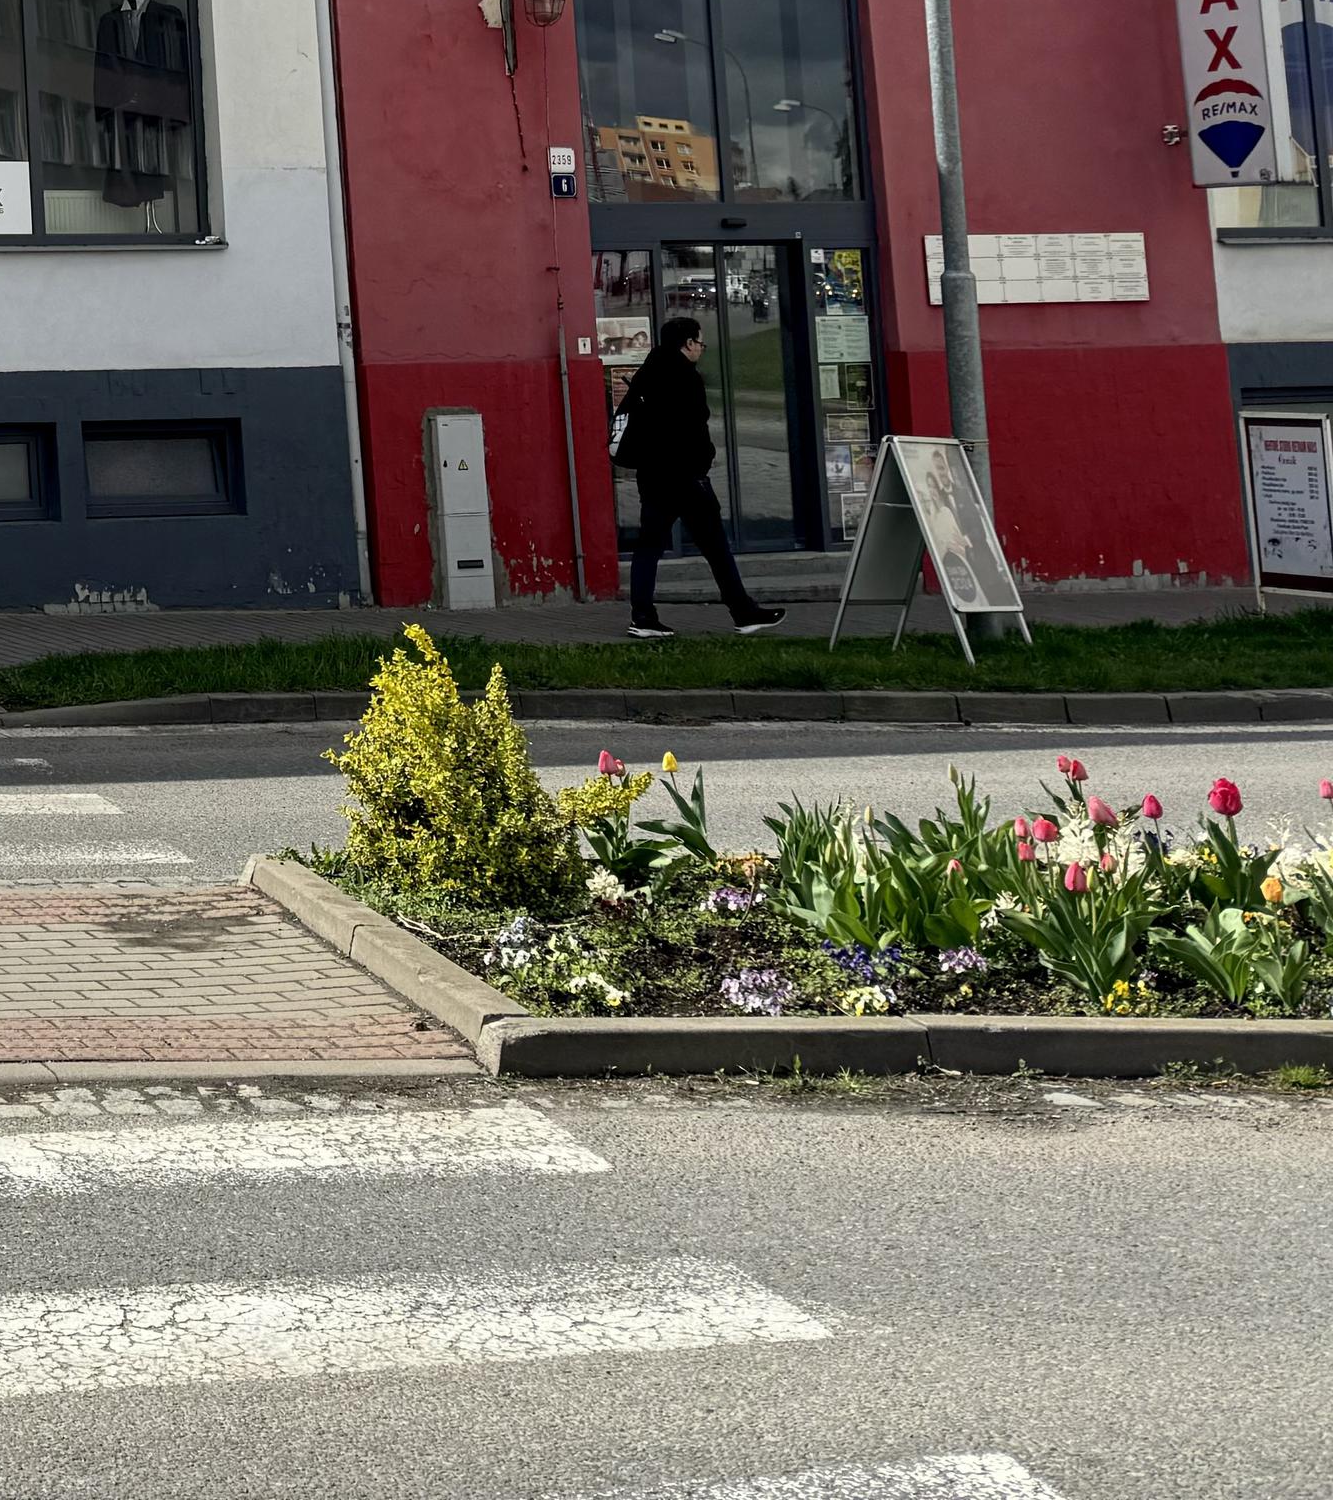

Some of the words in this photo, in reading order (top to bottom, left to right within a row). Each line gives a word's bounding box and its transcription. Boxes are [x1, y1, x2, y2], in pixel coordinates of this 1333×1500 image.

[1201, 101, 1259, 121] RE/MAX
[552, 155, 572, 165] 2359
[561, 179, 568, 192] 6
